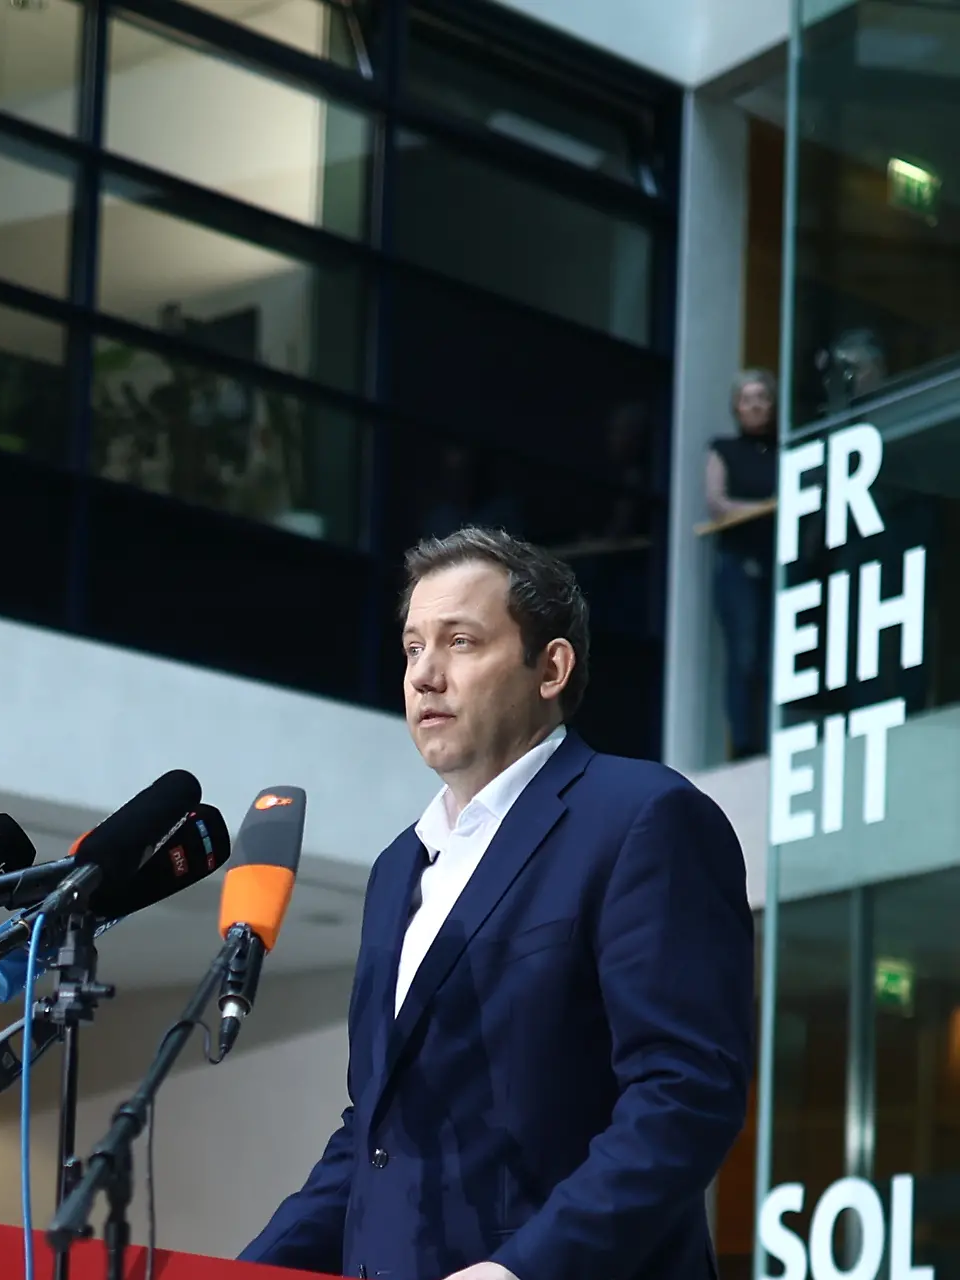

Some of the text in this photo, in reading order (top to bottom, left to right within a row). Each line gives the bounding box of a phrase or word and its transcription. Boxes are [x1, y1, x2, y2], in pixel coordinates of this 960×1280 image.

[777, 422, 885, 566] FR
[774, 545, 926, 705] EIH
[770, 697, 906, 846] EIT
